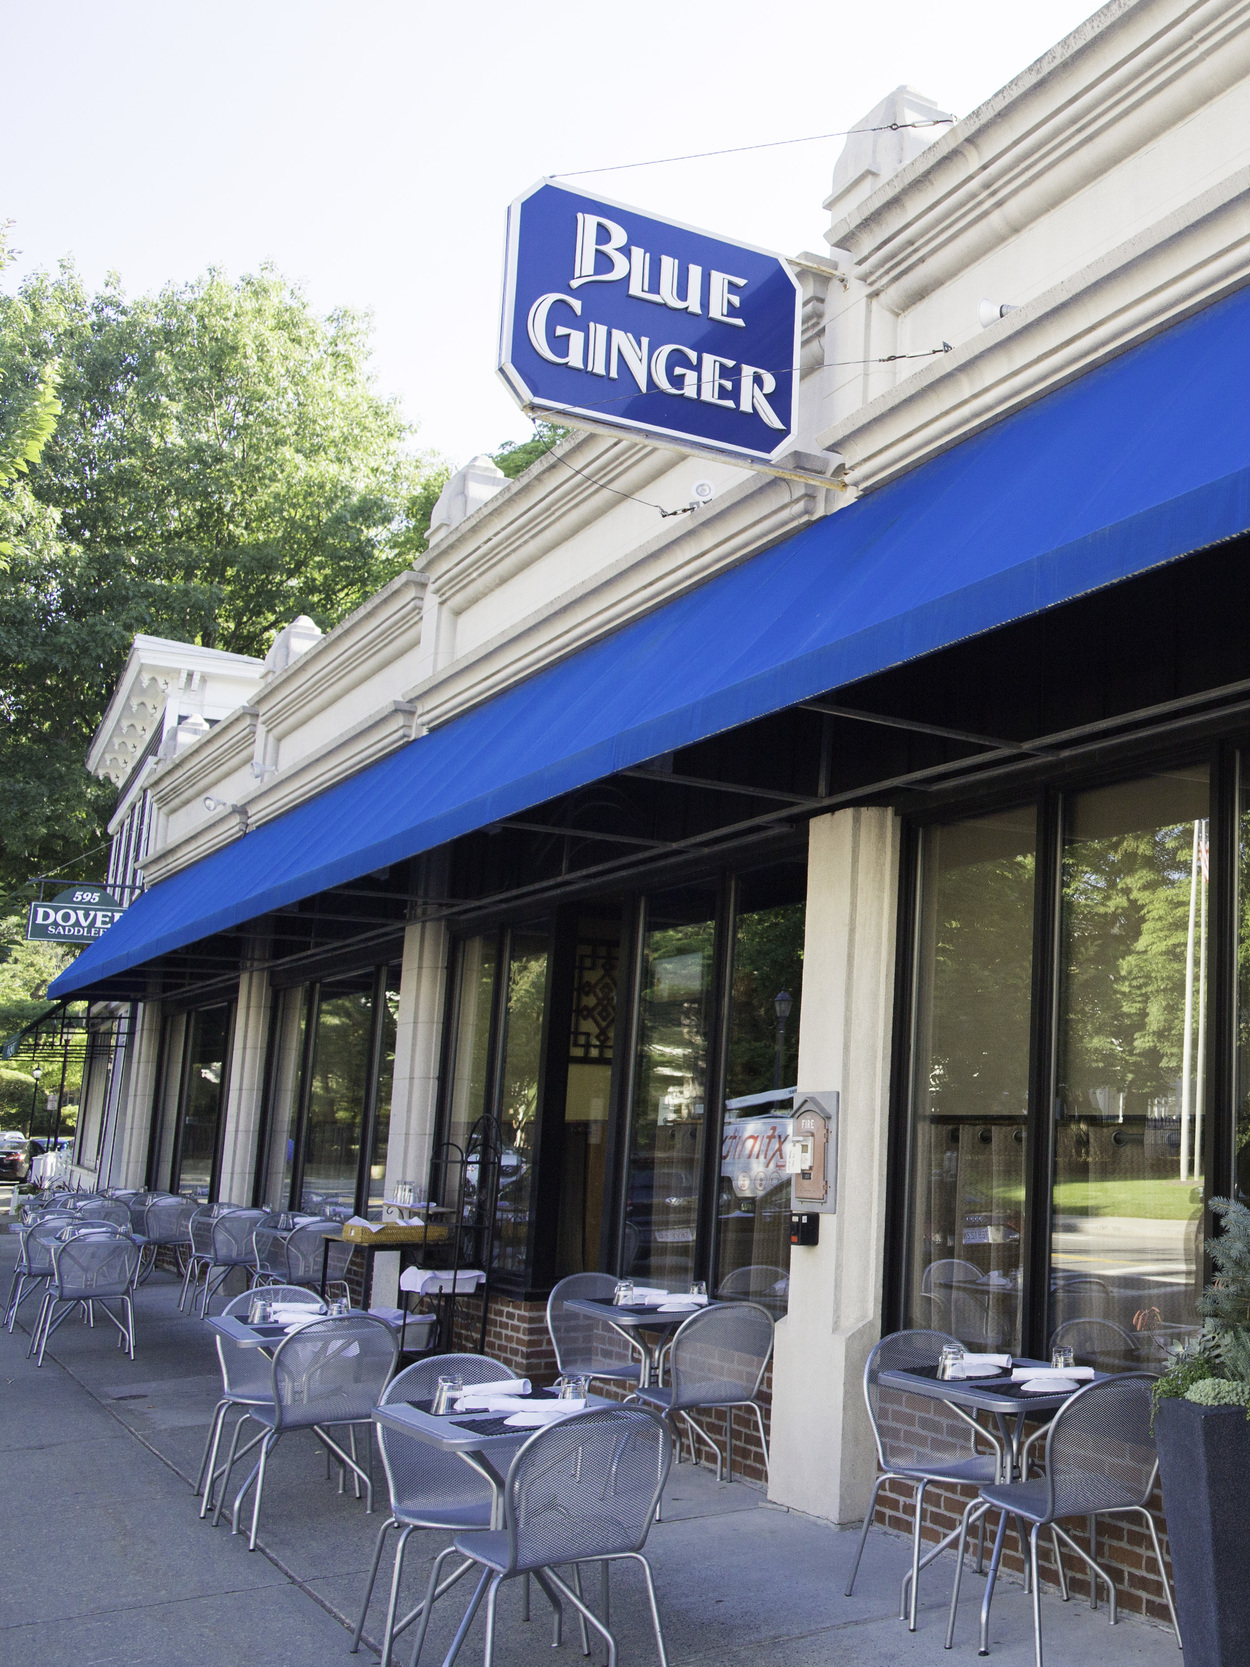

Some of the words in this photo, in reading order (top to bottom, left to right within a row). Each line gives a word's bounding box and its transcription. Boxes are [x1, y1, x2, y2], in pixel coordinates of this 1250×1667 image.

[569, 212, 749, 327] BLUE
[527, 292, 787, 430] GINGER
[72, 891, 101, 903] 595
[801, 1119, 815, 1129] FIRE
